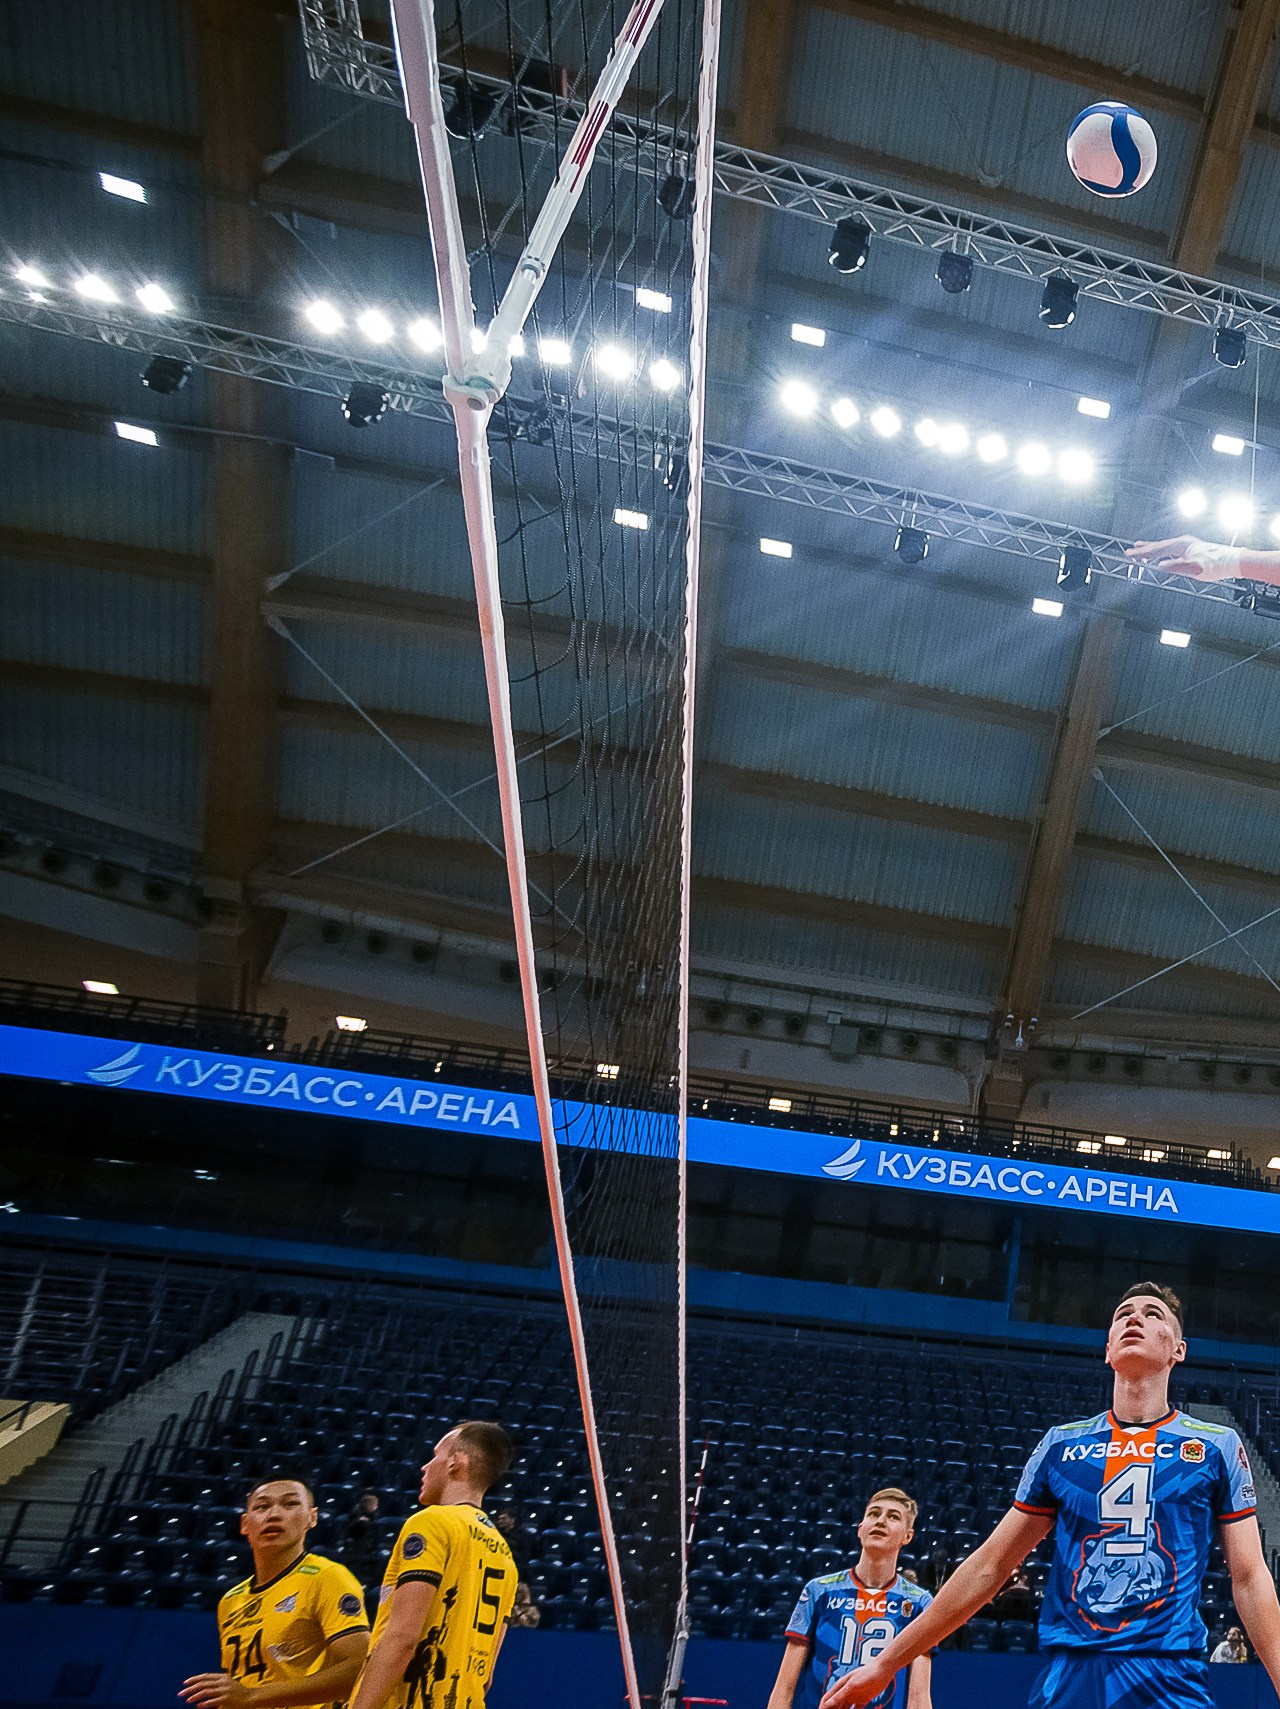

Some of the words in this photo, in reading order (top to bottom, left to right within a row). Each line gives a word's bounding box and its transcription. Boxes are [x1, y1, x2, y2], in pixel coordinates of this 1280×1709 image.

[1061, 1441, 1174, 1462] КУЗБАСС
[1099, 1463, 1153, 1538] 4
[473, 1559, 505, 1635] 15
[826, 1596, 898, 1614] КУЗБАСС
[840, 1616, 898, 1668] 12
